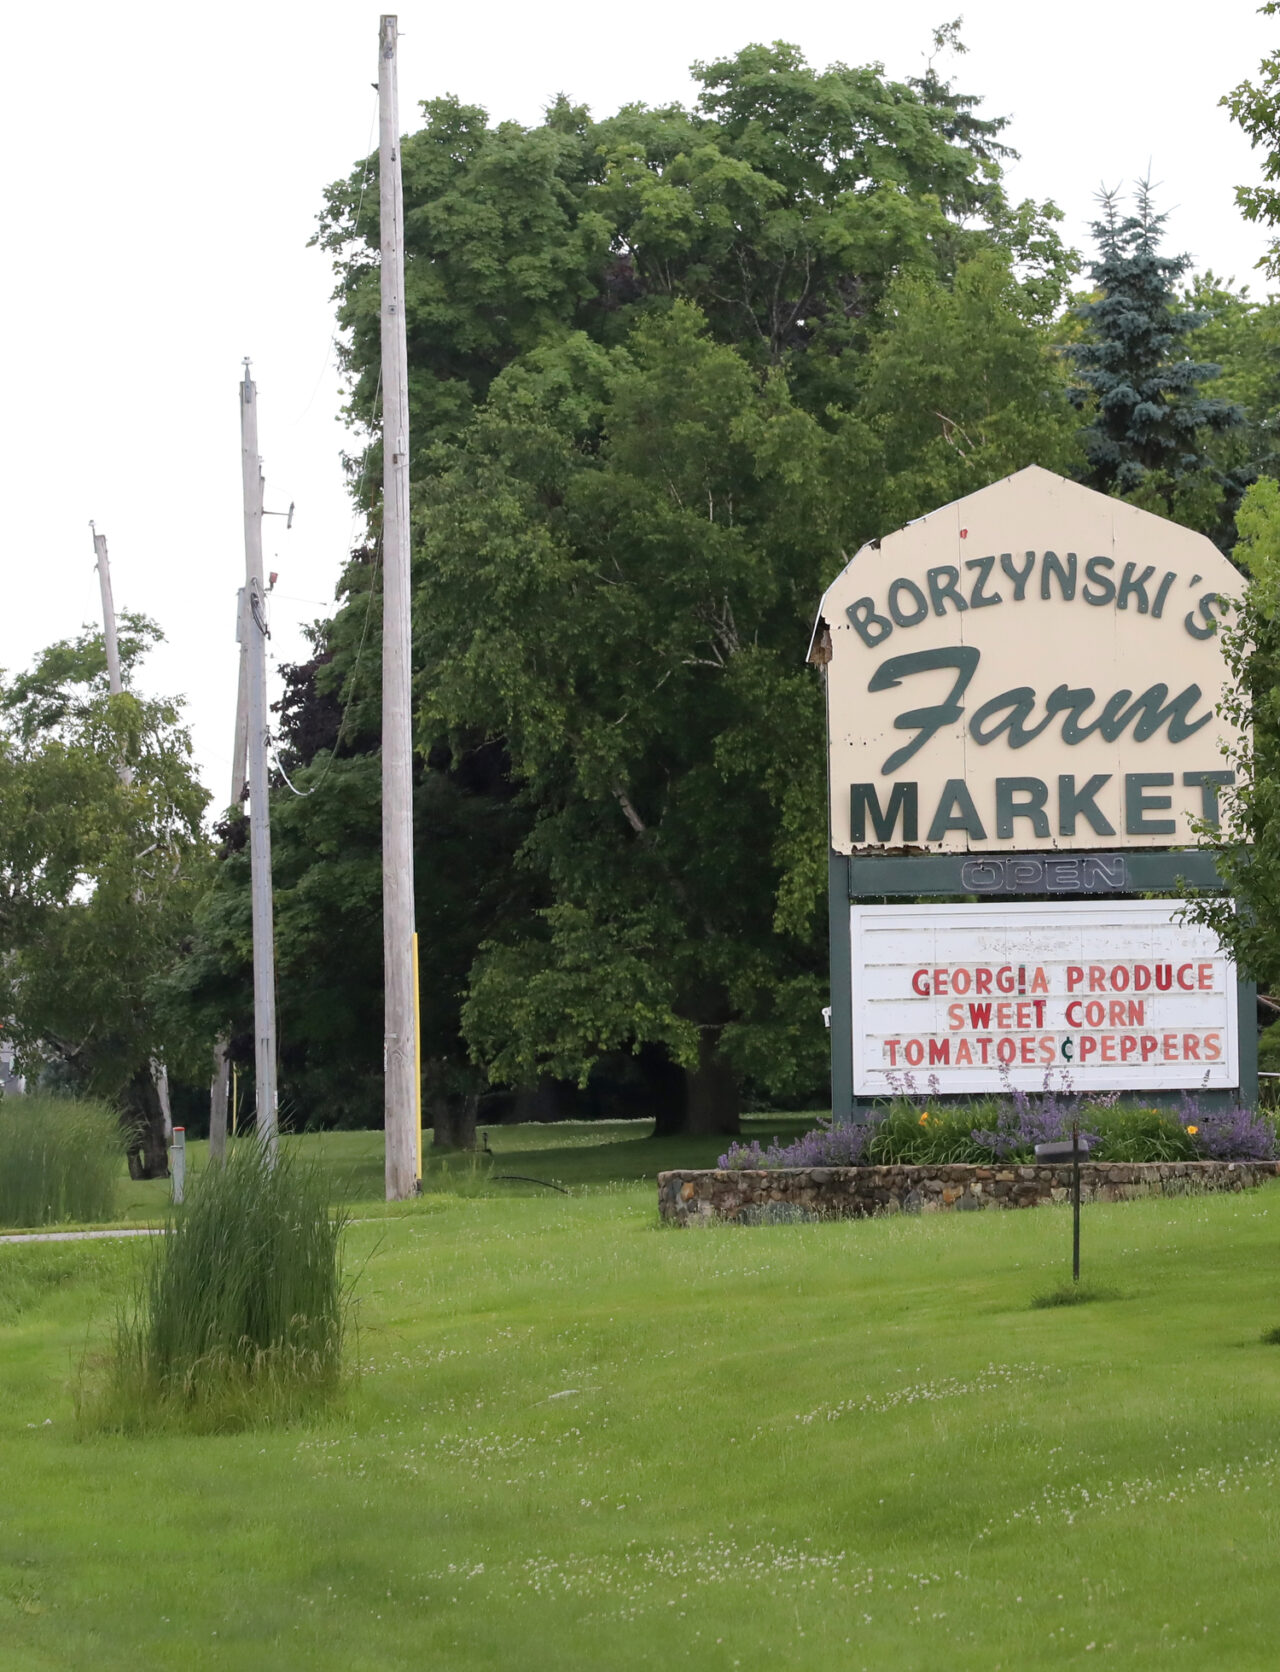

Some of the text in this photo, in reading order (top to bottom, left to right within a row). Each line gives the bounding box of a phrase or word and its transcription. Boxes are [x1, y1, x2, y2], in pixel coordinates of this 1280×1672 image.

[845, 550, 1229, 648] BORZYNSKI'S
[867, 645, 1213, 776] Farm
[849, 769, 1236, 843] MARKET
[961, 856, 1126, 891] OPEN
[1066, 962, 1214, 993] PRODUCE
[948, 1000, 1145, 1031] SWEET CORN
